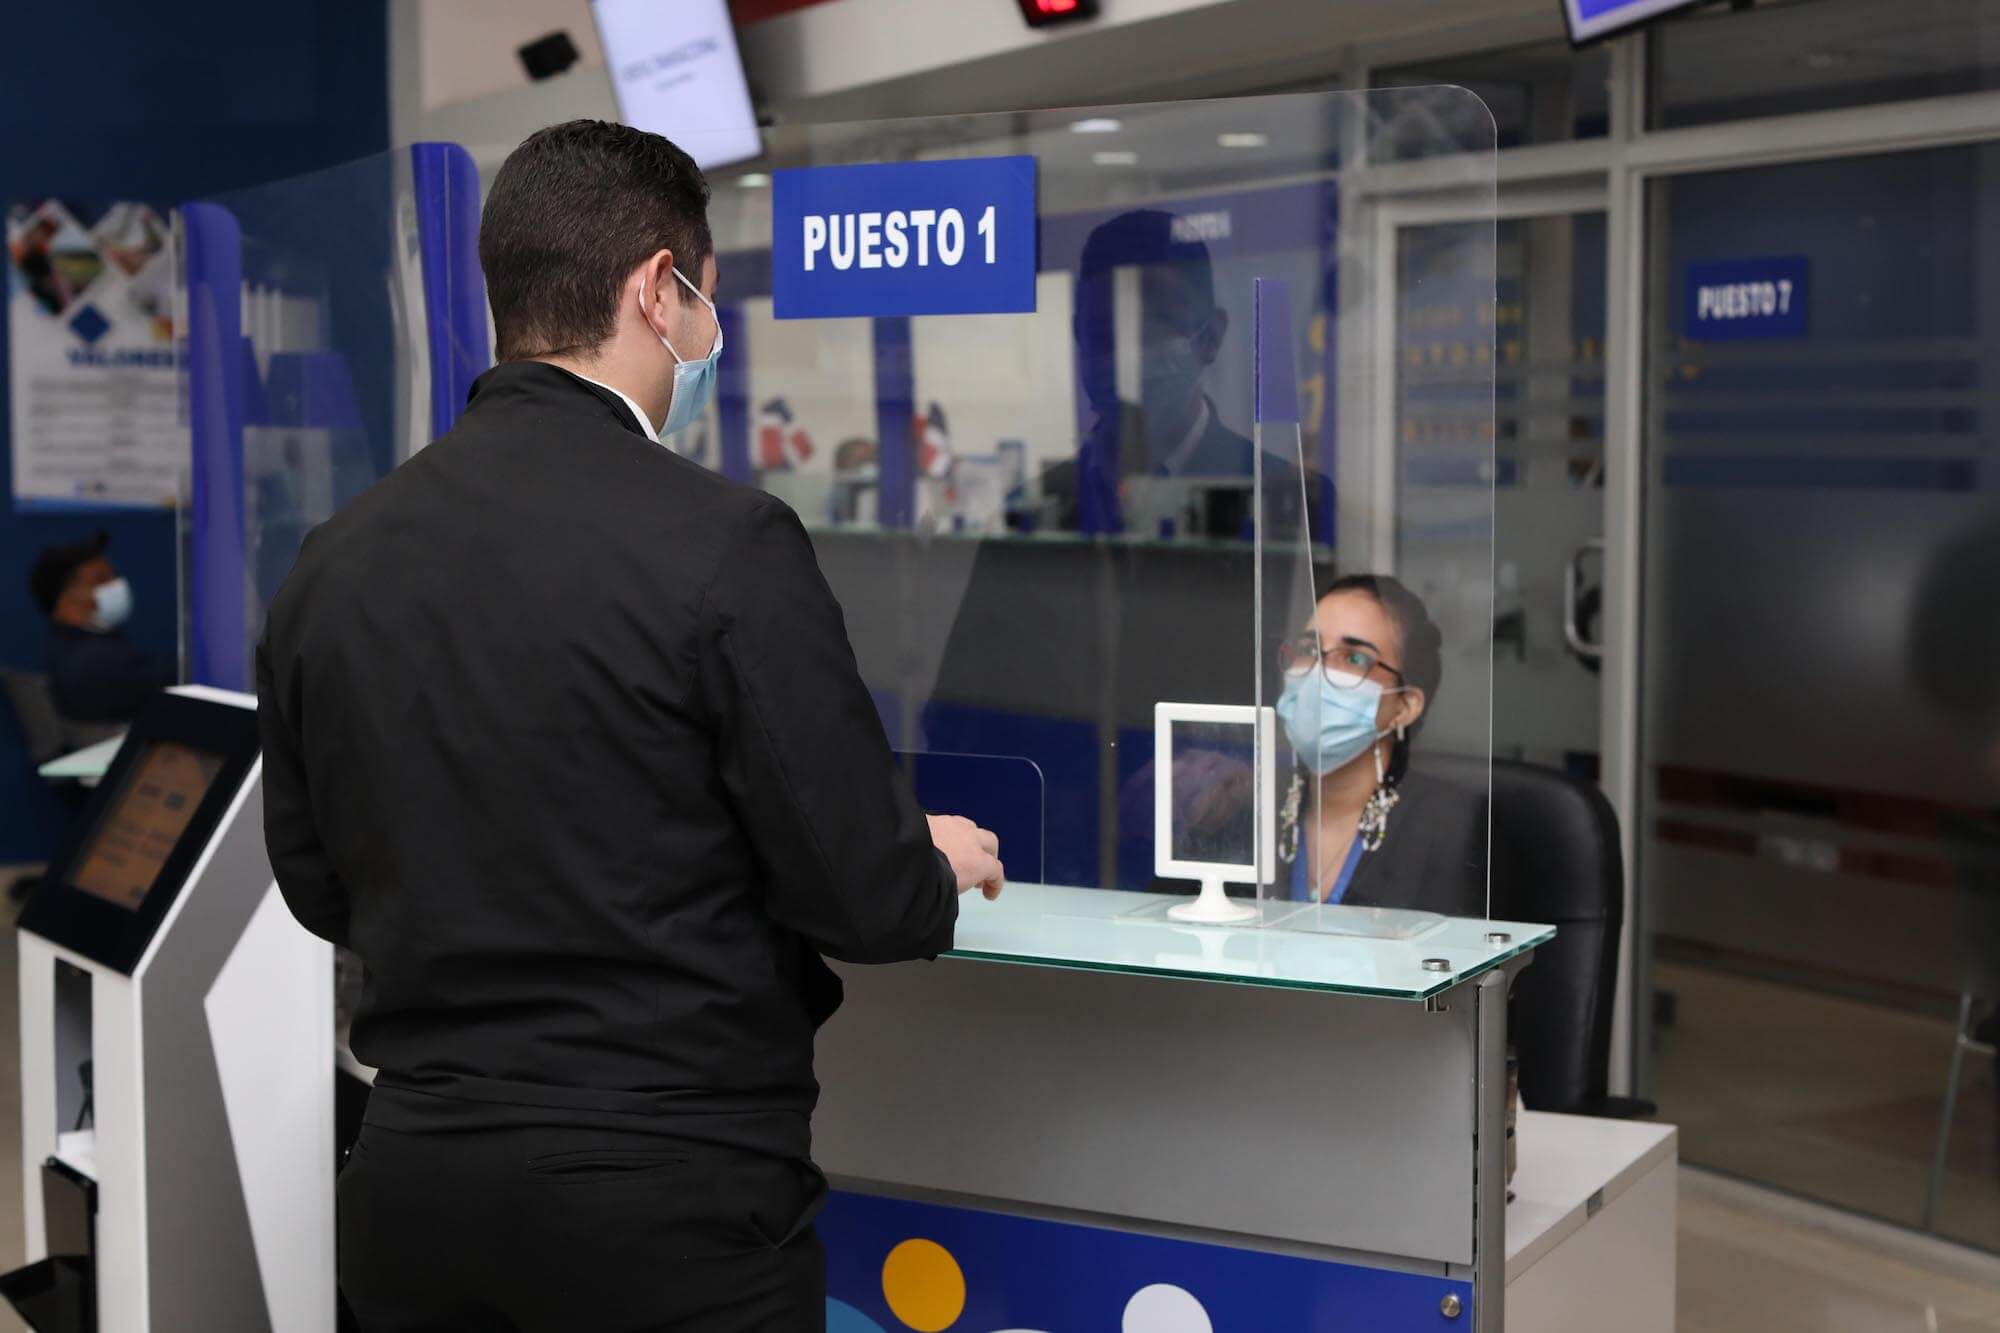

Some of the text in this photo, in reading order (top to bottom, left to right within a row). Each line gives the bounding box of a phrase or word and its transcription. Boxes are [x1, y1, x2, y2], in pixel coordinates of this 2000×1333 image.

[803, 206, 996, 272] PUESTO 1
[1698, 280, 1793, 320] PUESTO 7
